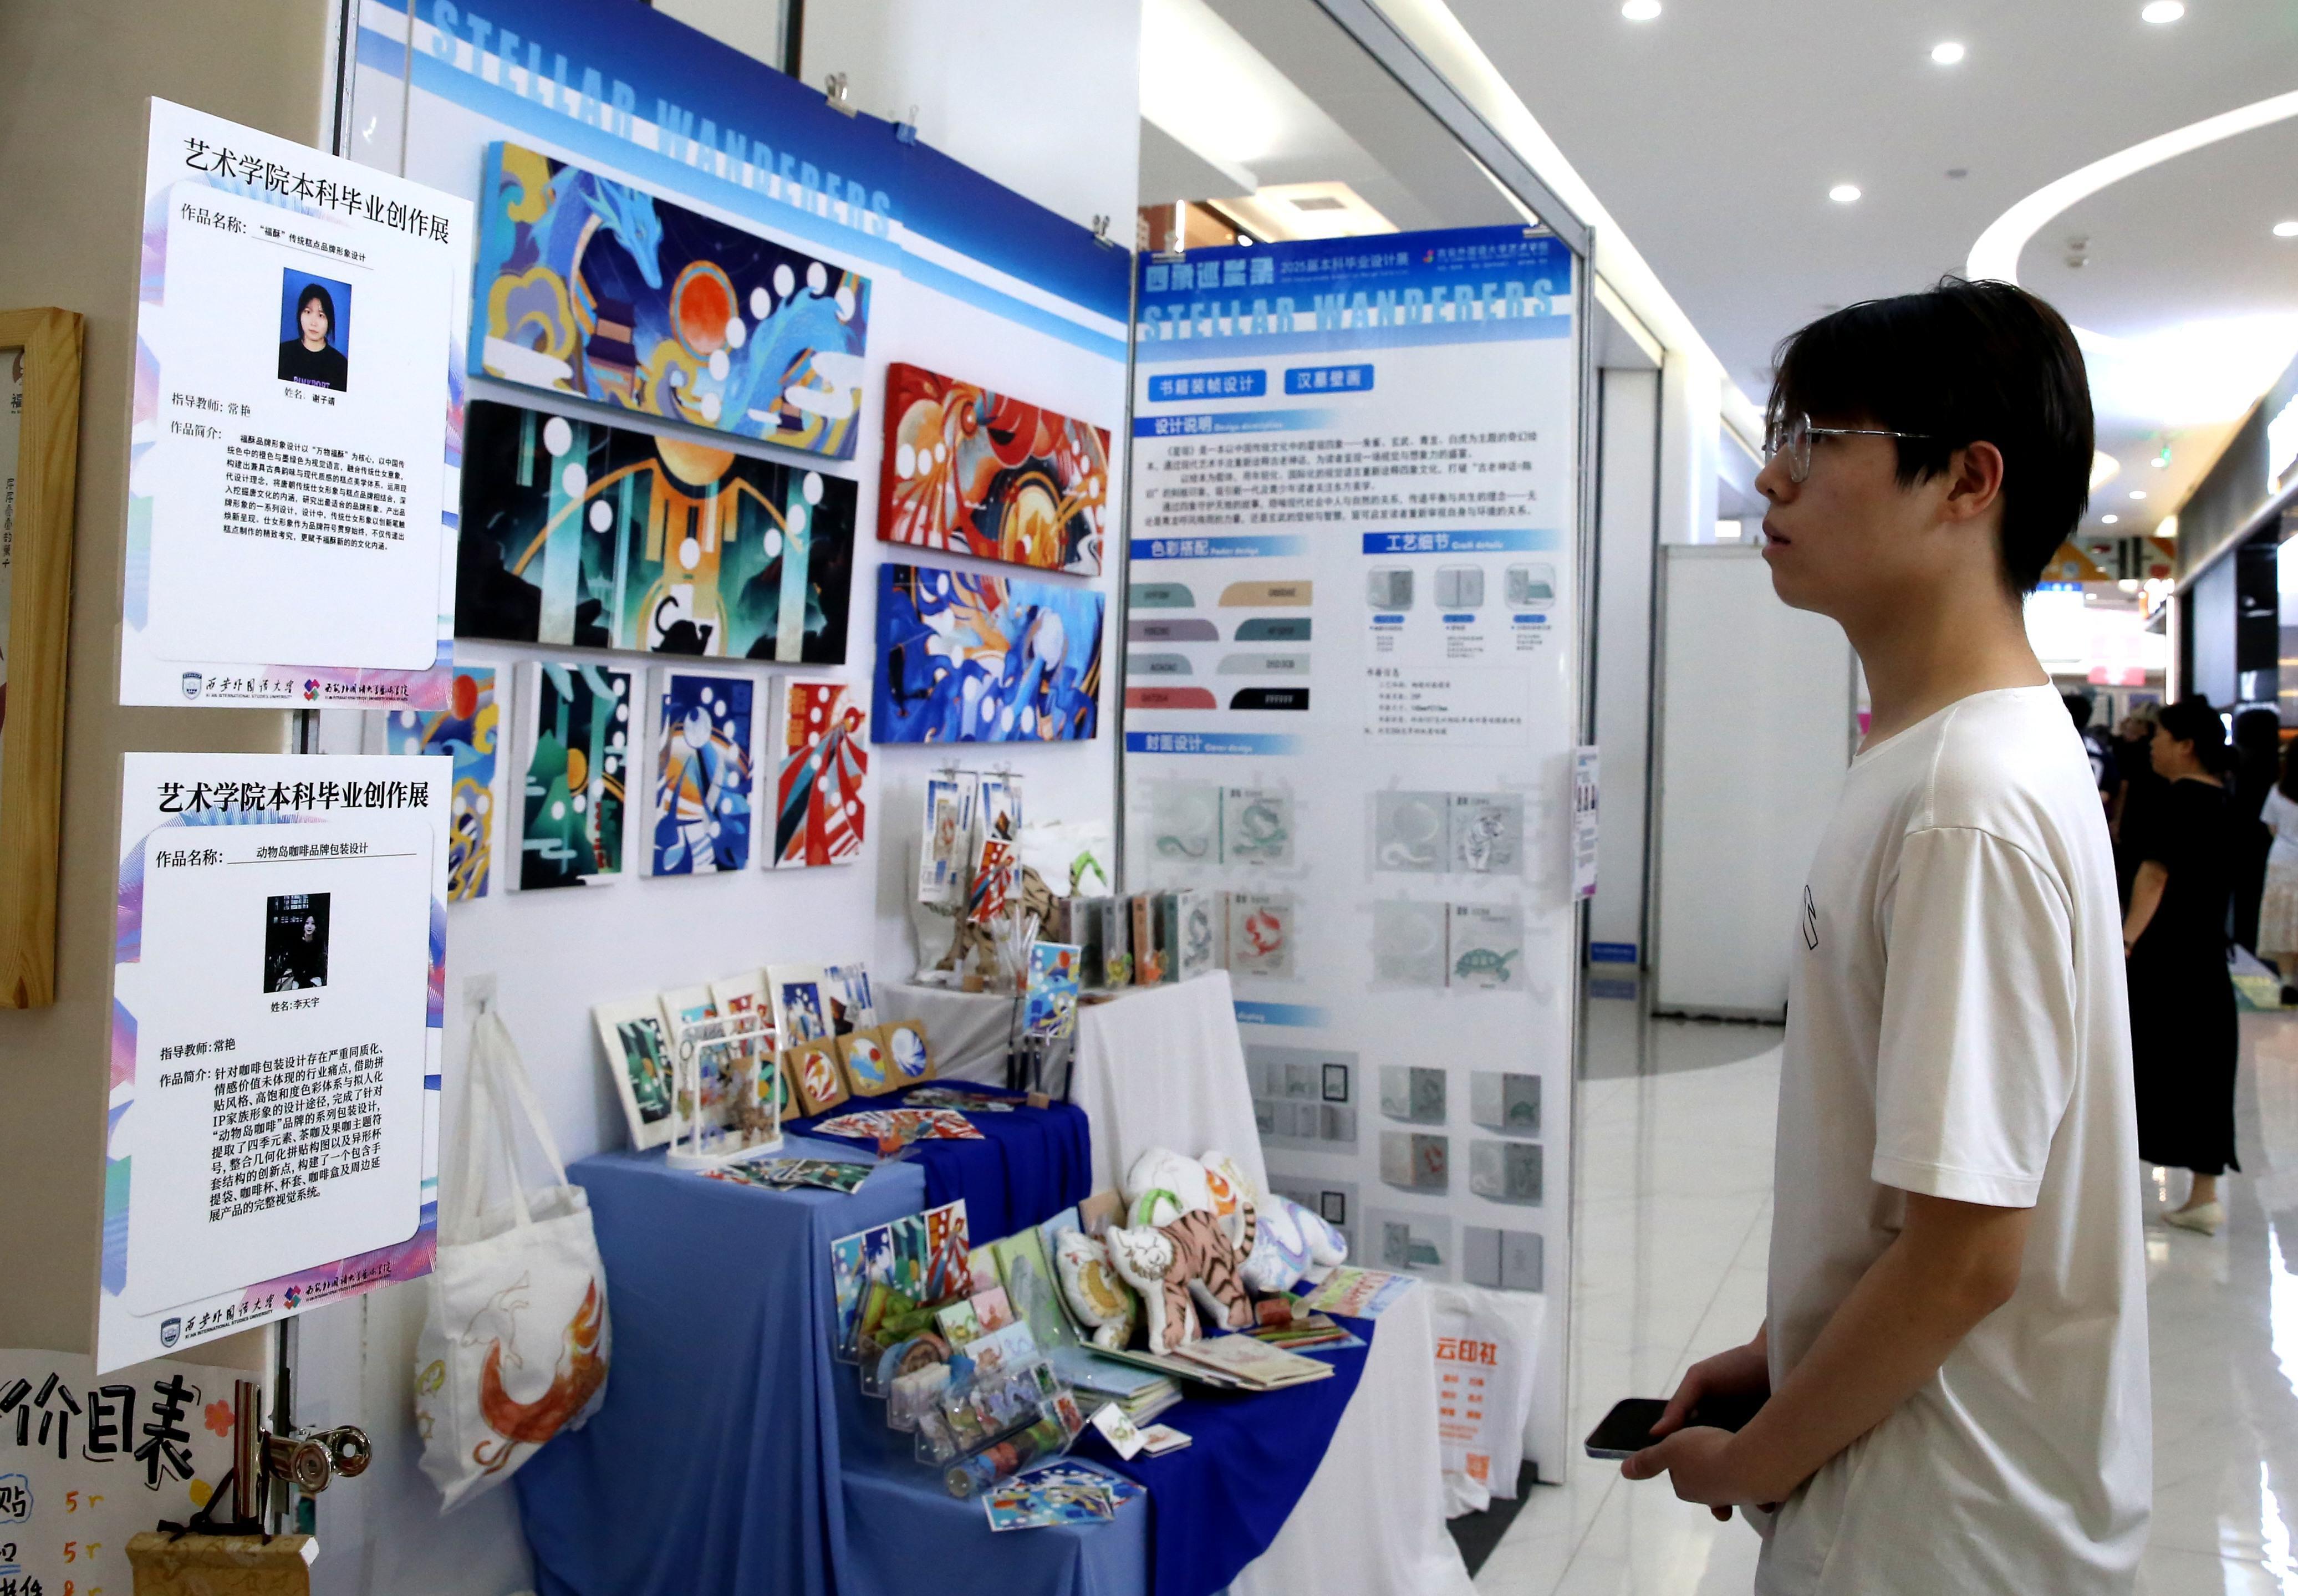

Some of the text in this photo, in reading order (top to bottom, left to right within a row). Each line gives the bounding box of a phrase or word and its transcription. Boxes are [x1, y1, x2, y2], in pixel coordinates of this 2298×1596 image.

[430, 2, 891, 236] STELLAR WANDERERS
[184, 137, 450, 244] 艺术学院本科毕业创作展
[181, 203, 247, 234] 作品名称：
[1144, 279, 1553, 341] STELLAR WANDERERS
[171, 420, 222, 440] 作品简介：
[1155, 416, 1213, 435] 设计说明
[1151, 539, 1209, 558] 色彩搭配
[1386, 533, 1450, 551] 工艺细节
[206, 677, 294, 694] 西安外国语大学
[1145, 735, 1202, 752] 封面设计
[157, 781, 430, 813] 艺术学院本科毕业创作展
[155, 842, 369, 868] 作品名称： 动物岛咖啡品牌包装设计
[160, 1038, 236, 1061] 指导教师：常艳
[213, 1071, 384, 1112] 贴风格、高饱和度色彩体系与拟人化
[214, 1057, 384, 1097] 情感价值未体现的行业痛点，借助拼
[212, 1101, 381, 1143] “动物岛咖啡”品牌的系列包装设计，
[213, 1085, 384, 1128] IP家族形象的设计途径，完成了针对
[211, 1114, 383, 1159] 提取了四季元素、茶咖及果咖主题符
[211, 1128, 382, 1175] 号，整合几何化拼贴构图以及异形杯
[210, 1143, 381, 1191] 套结构的创新点，构建了一个包含手
[210, 1157, 381, 1207] 提袋、咖啡杯、杯套、咖啡盒及周边延
[208, 1187, 321, 1223] 展产品的完整视觉系统。
[185, 1293, 275, 1332] 西安外国语大学
[197, 1322, 231, 1336] INTERNATIONAL
[231, 1316, 249, 1325] STUDIES
[249, 1309, 274, 1320] UNIVERSITY
[1436, 1337, 1498, 1366] 云印社
